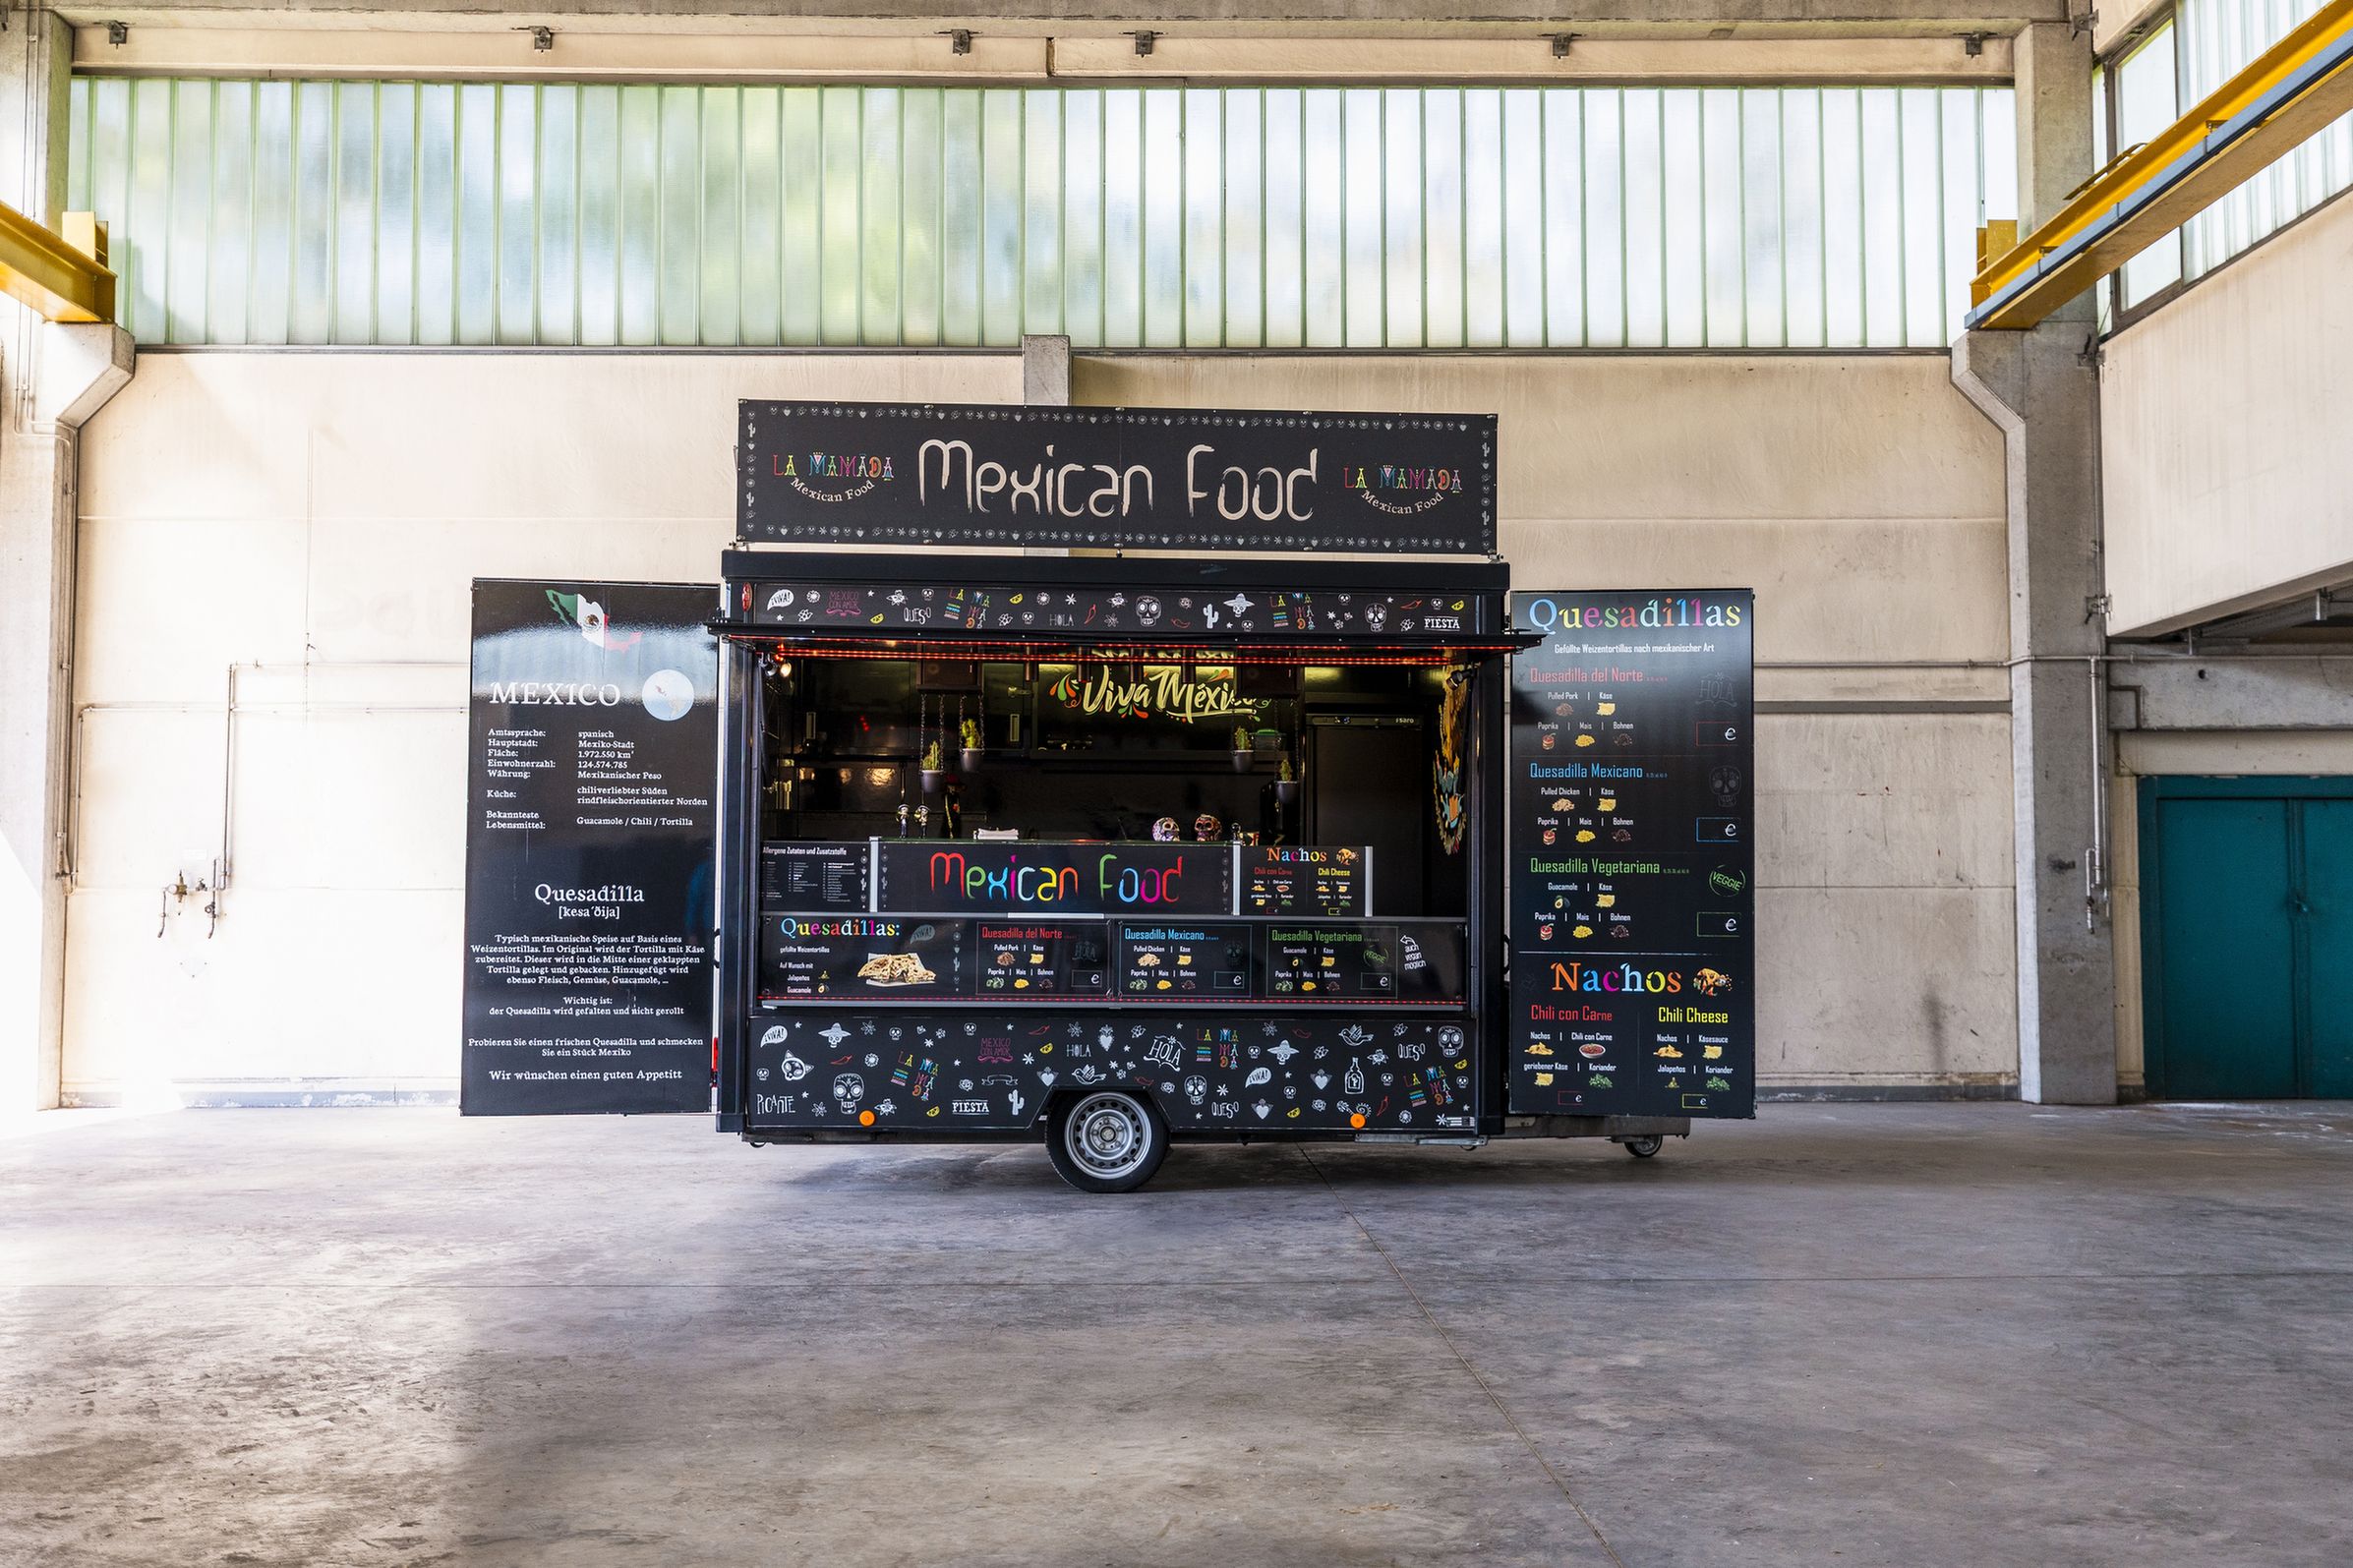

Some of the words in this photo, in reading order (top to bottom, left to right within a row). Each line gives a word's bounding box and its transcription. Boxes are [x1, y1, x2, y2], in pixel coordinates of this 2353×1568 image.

[773, 454, 796, 476] LA
[809, 452, 894, 481] MAMADA
[918, 438, 1153, 518] Mexican
[1187, 443, 1319, 523] Food
[1343, 467, 1367, 489] LA
[1380, 465, 1462, 494] MAMADA
[791, 477, 843, 502] Mexican
[846, 480, 874, 499] Food
[1361, 490, 1412, 514] Mexican
[1415, 493, 1443, 512] Food
[904, 607, 932, 625] QUESO
[1049, 613, 1074, 626] HOLA
[1424, 617, 1460, 630] FIESTA
[1529, 598, 1741, 635] Quesadillas
[1555, 644, 1580, 654] Gefüllte
[1582, 644, 1632, 654] Weizentortillas
[1652, 644, 1701, 653] mexikanischer
[1530, 668, 1587, 683] Quesadilla
[1591, 668, 1608, 682] del
[1612, 668, 1643, 682] Norte
[490, 682, 620, 706] MEXICO
[1083, 665, 1151, 714] Viva
[489, 728, 546, 737] Amtssprache:
[488, 759, 556, 768] Einwohnerzahl:
[1530, 763, 1588, 779] Quesadilla
[1591, 763, 1643, 779] Mexicano
[488, 770, 530, 779] Währung:
[1266, 847, 1326, 862] Nachos
[1530, 858, 1588, 874] Quesadilla
[1592, 858, 1660, 876] Vegetariana
[930, 852, 1079, 901] Mexican
[1099, 853, 1182, 902] Food
[1712, 872, 1742, 891] VEGGIE
[535, 884, 644, 904] Quesadilla
[781, 918, 900, 939] Quesadillas:
[982, 927, 1023, 939] Quesadilla
[1026, 927, 1037, 938] del
[1040, 928, 1062, 939] Norte
[1125, 928, 1165, 940] Quesadilla
[1168, 929, 1205, 940] Mexicano
[1271, 929, 1313, 942] Quesadilla
[1315, 931, 1362, 944] Vegetariana
[653, 956, 700, 964] geklappten
[539, 976, 570, 985] Fleisch,
[573, 976, 610, 985] Gemüse,
[613, 976, 660, 985] Guacamole,
[1551, 961, 1681, 993] Nachos
[563, 997, 598, 1006] Wichtig
[1531, 1005, 1555, 1020] Chili
[1559, 1009, 1578, 1020] con
[1582, 1006, 1613, 1021] Carne
[1659, 1008, 1682, 1023] Chili
[1686, 1008, 1728, 1023] Cheese
[469, 1038, 511, 1047] Probieren
[593, 1038, 637, 1047] Quesadilla
[1066, 1044, 1091, 1058] HOLA
[1148, 1039, 1180, 1065] HOLA
[1398, 1043, 1426, 1061] QUESO
[489, 1071, 511, 1079] Wir
[514, 1071, 567, 1079] wünschen
[570, 1071, 599, 1079] einen
[604, 1071, 633, 1081] guten
[636, 1071, 682, 1081] Appetitt
[757, 1093, 795, 1114] PICANTE
[952, 1101, 989, 1113] FIESTA
[1211, 1101, 1239, 1119] QUESO
